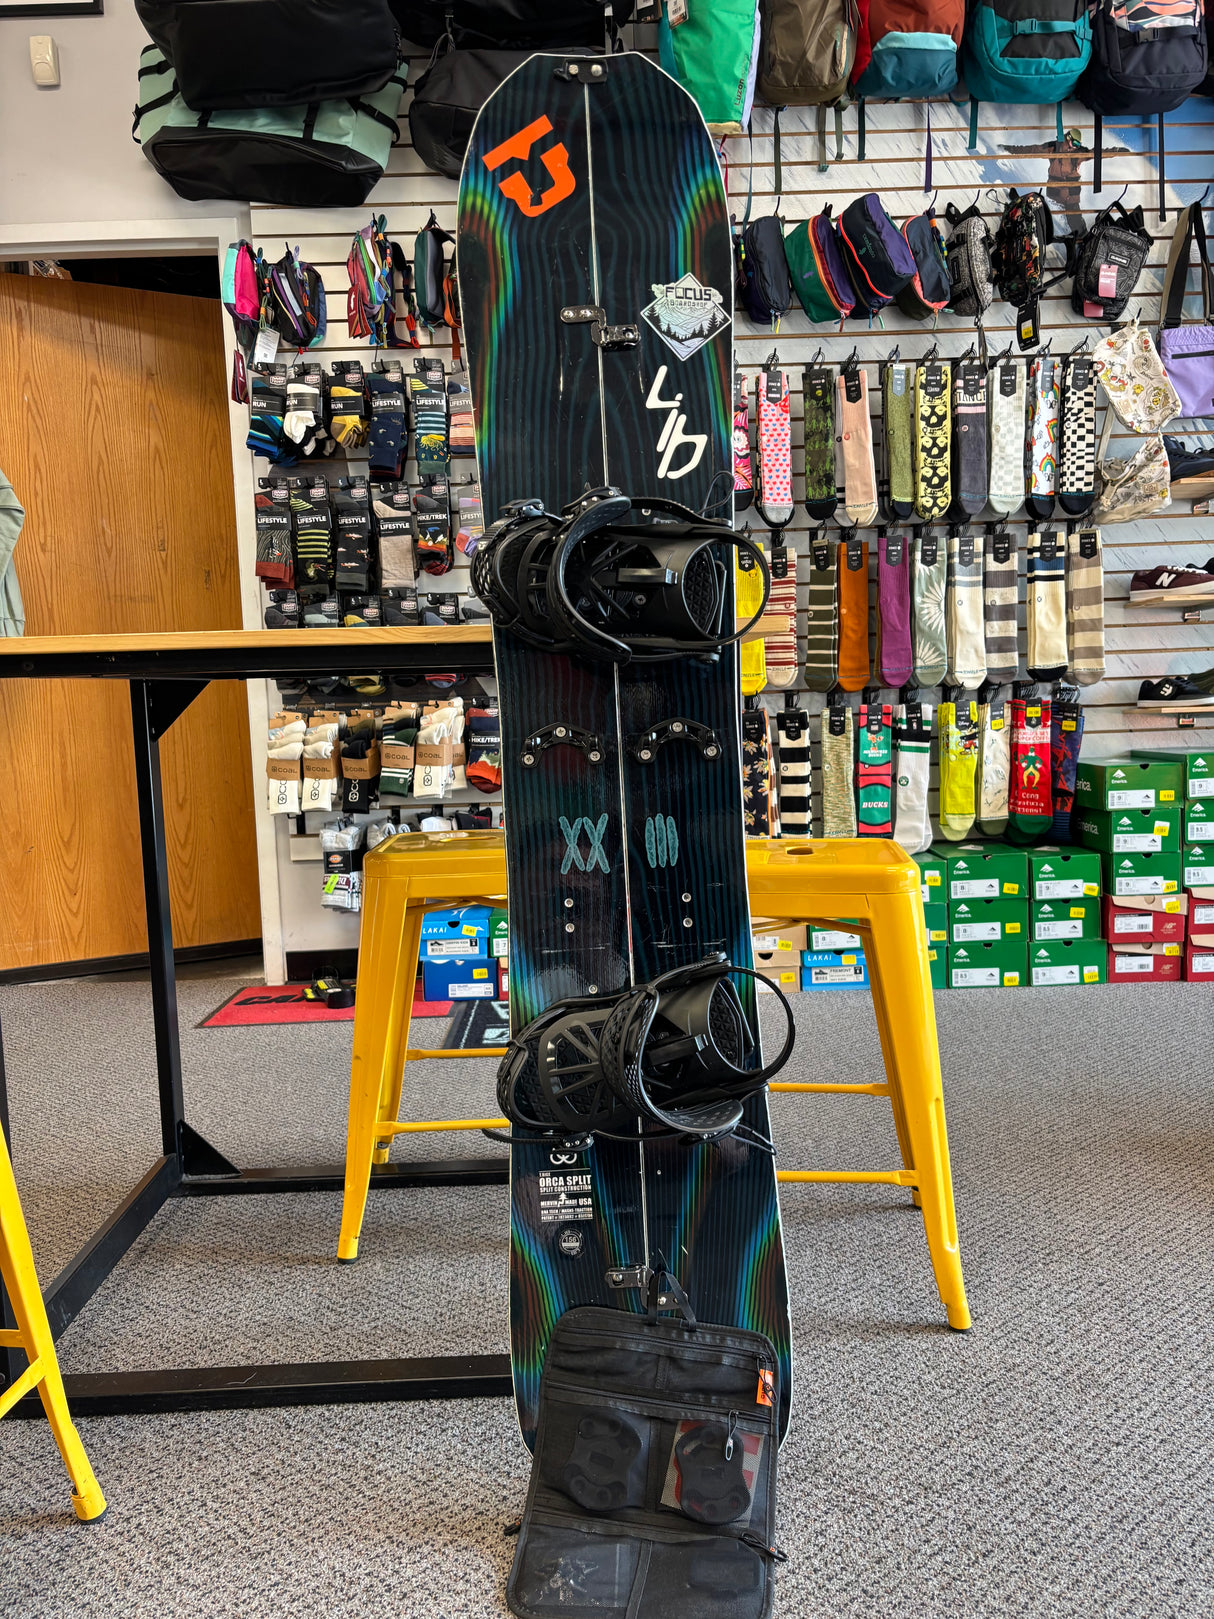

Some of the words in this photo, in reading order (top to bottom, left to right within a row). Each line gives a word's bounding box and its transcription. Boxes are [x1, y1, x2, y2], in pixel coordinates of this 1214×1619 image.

[734, 78, 745, 106] Luzon
[665, 286, 712, 301] FOCUS
[372, 399, 401, 408] LIFESTYLE
[449, 399, 472, 407] LIFESTYL
[297, 515, 327, 524] LIFESTYLE
[380, 522, 410, 530] LIFESTYLE
[1155, 572, 1177, 588] N
[1076, 779, 1092, 791] erica.
[539, 1177, 565, 1187] ORCA
[566, 1175, 592, 1185] SPLIT
[554, 1184, 592, 1192] CONSTRUCTION
[579, 1198, 592, 1206] USA
